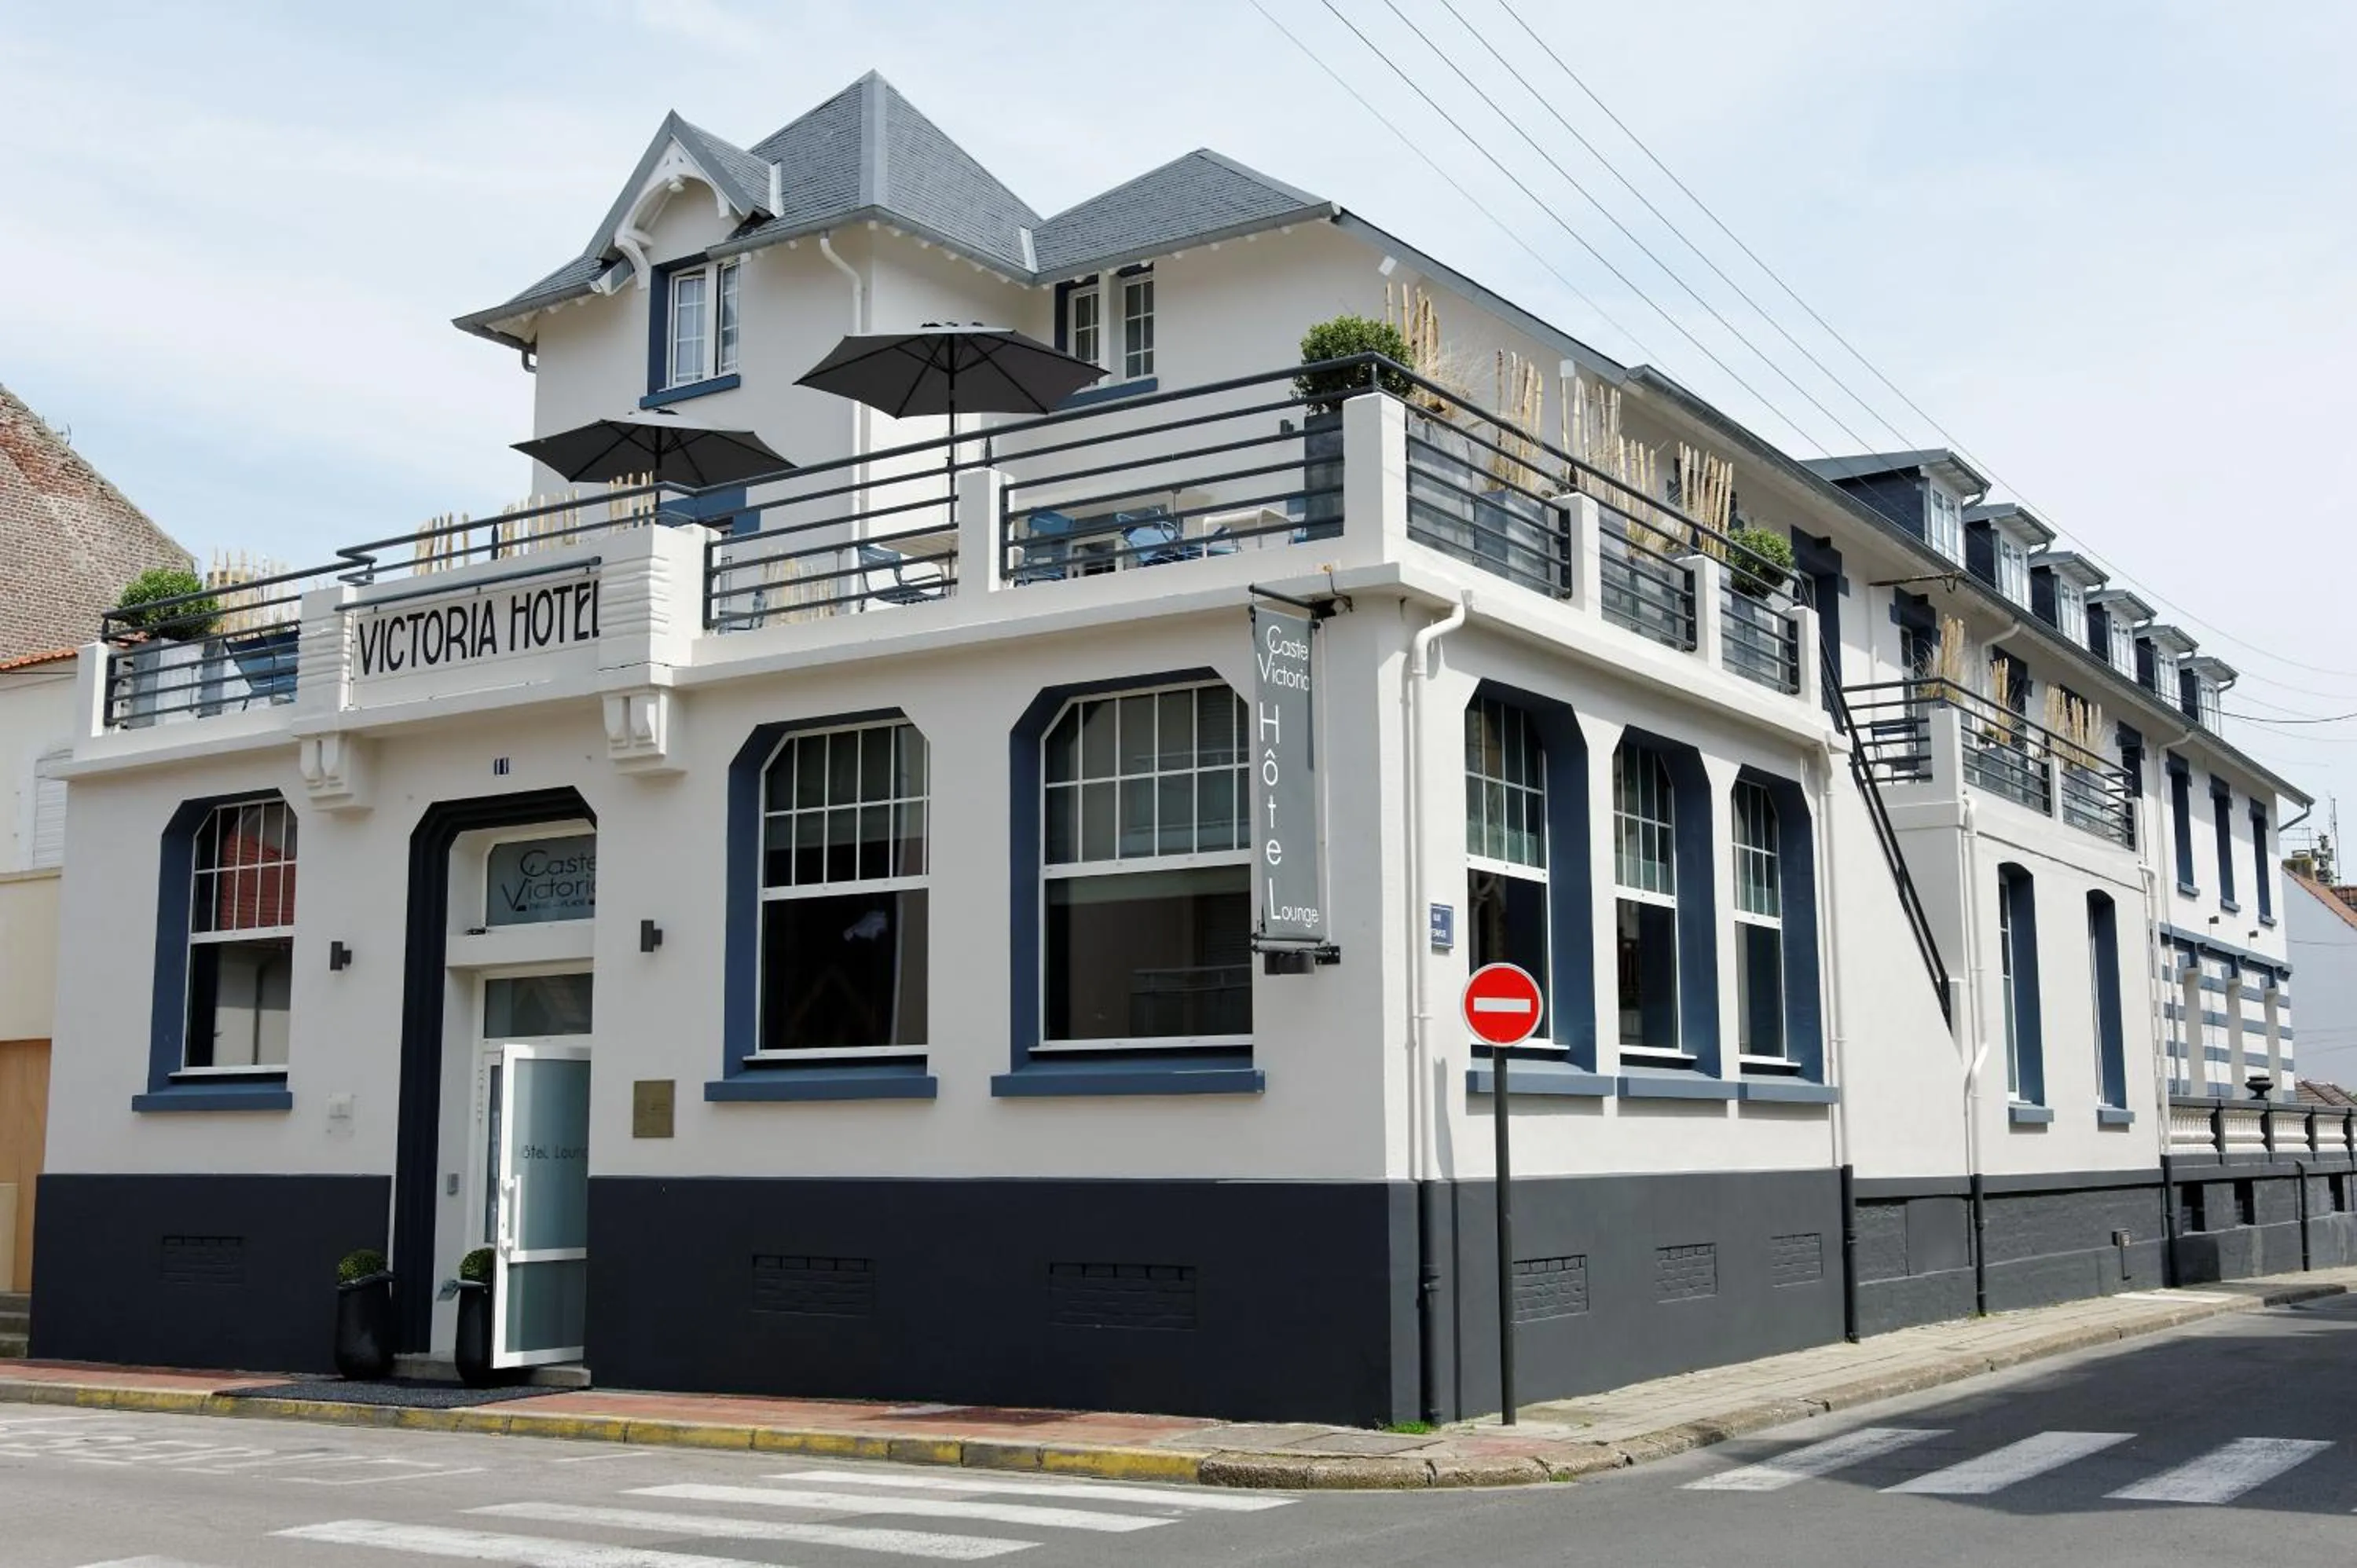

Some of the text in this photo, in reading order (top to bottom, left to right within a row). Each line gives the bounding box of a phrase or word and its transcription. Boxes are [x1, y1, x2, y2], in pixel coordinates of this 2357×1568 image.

[359, 580, 599, 676] VICTORIA HOTEL
[1269, 877, 1319, 928] Lounge
